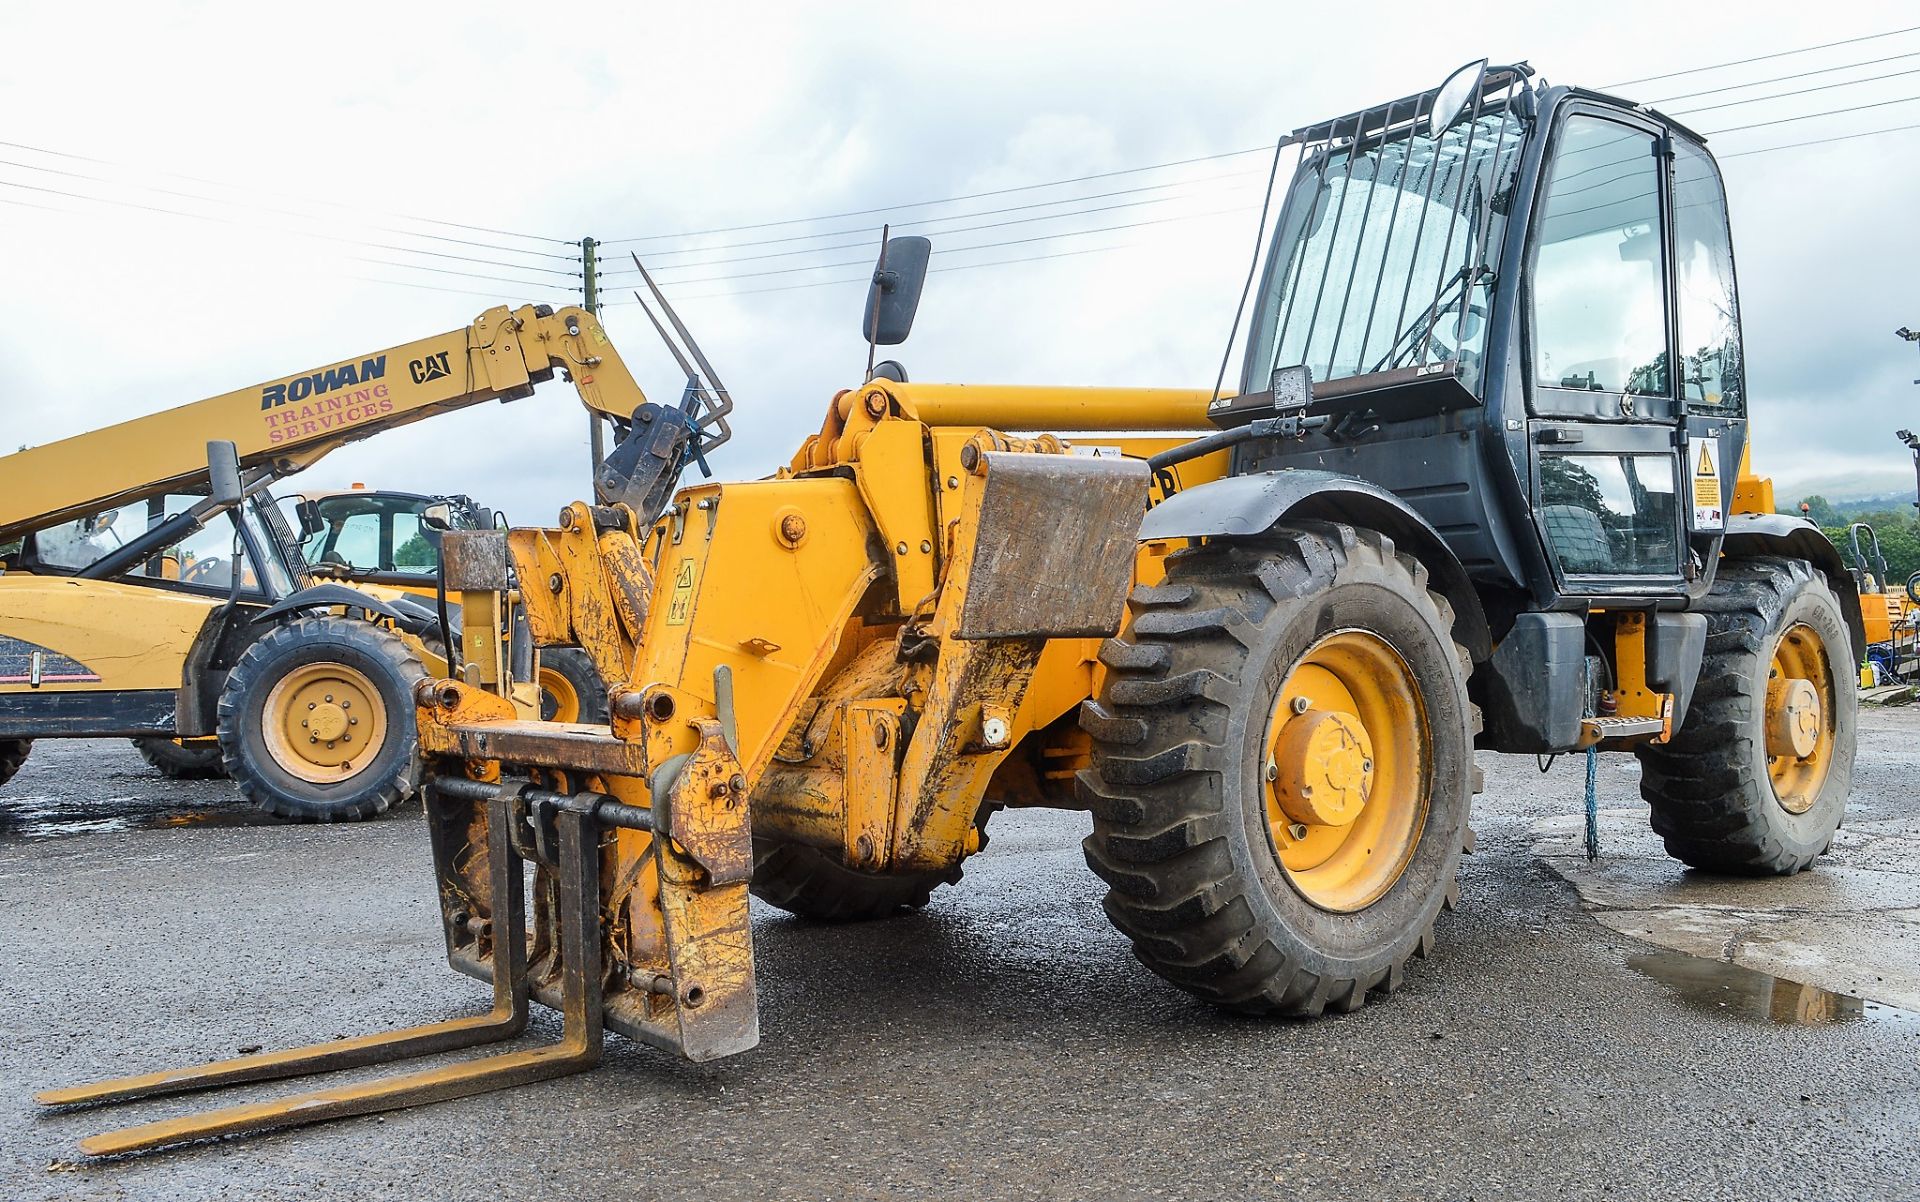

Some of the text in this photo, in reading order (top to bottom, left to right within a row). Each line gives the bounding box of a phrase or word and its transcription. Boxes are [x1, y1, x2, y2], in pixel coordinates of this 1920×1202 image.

[260, 355, 387, 411] ROWAN
[408, 351, 451, 385] CAT
[265, 384, 389, 428] TRAINING
[269, 399, 394, 444] SERVICES
